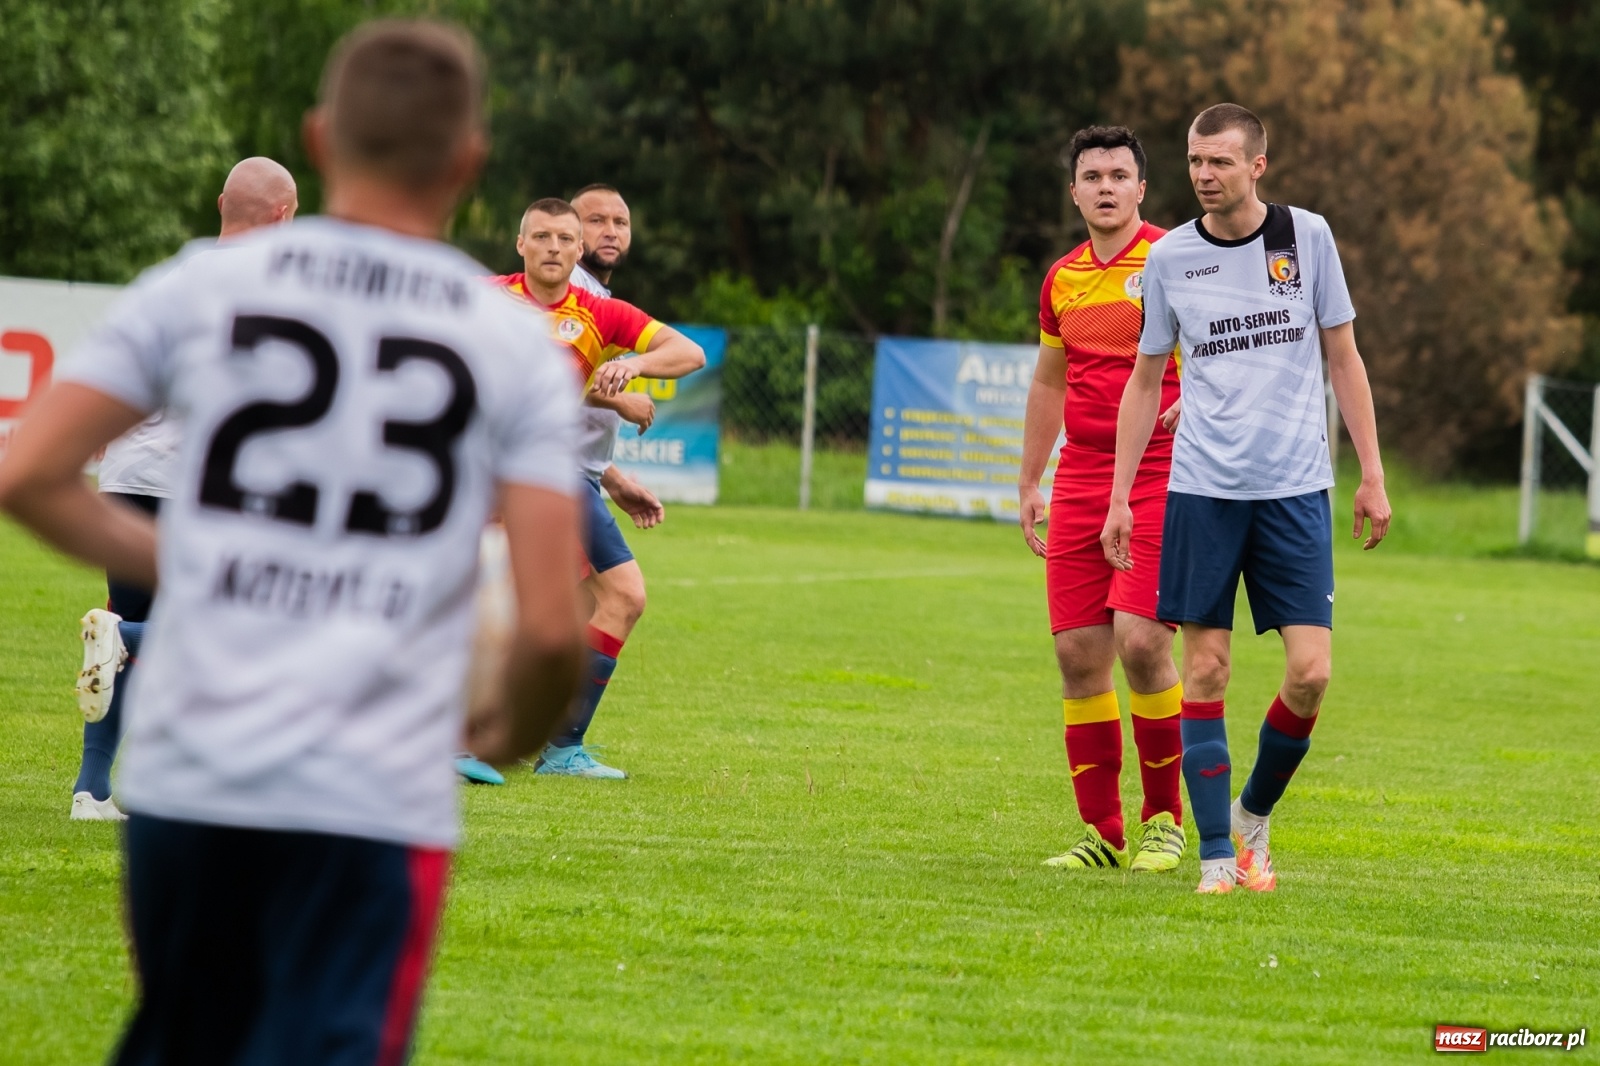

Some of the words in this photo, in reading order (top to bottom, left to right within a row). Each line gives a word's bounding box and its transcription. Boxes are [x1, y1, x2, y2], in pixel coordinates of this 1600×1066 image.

[1209, 309, 1291, 336] AUTO-SERWIS
[1191, 335, 1250, 359] MIROSŁAW
[1251, 327, 1306, 349] WIECZORE
[198, 315, 477, 538] 23
